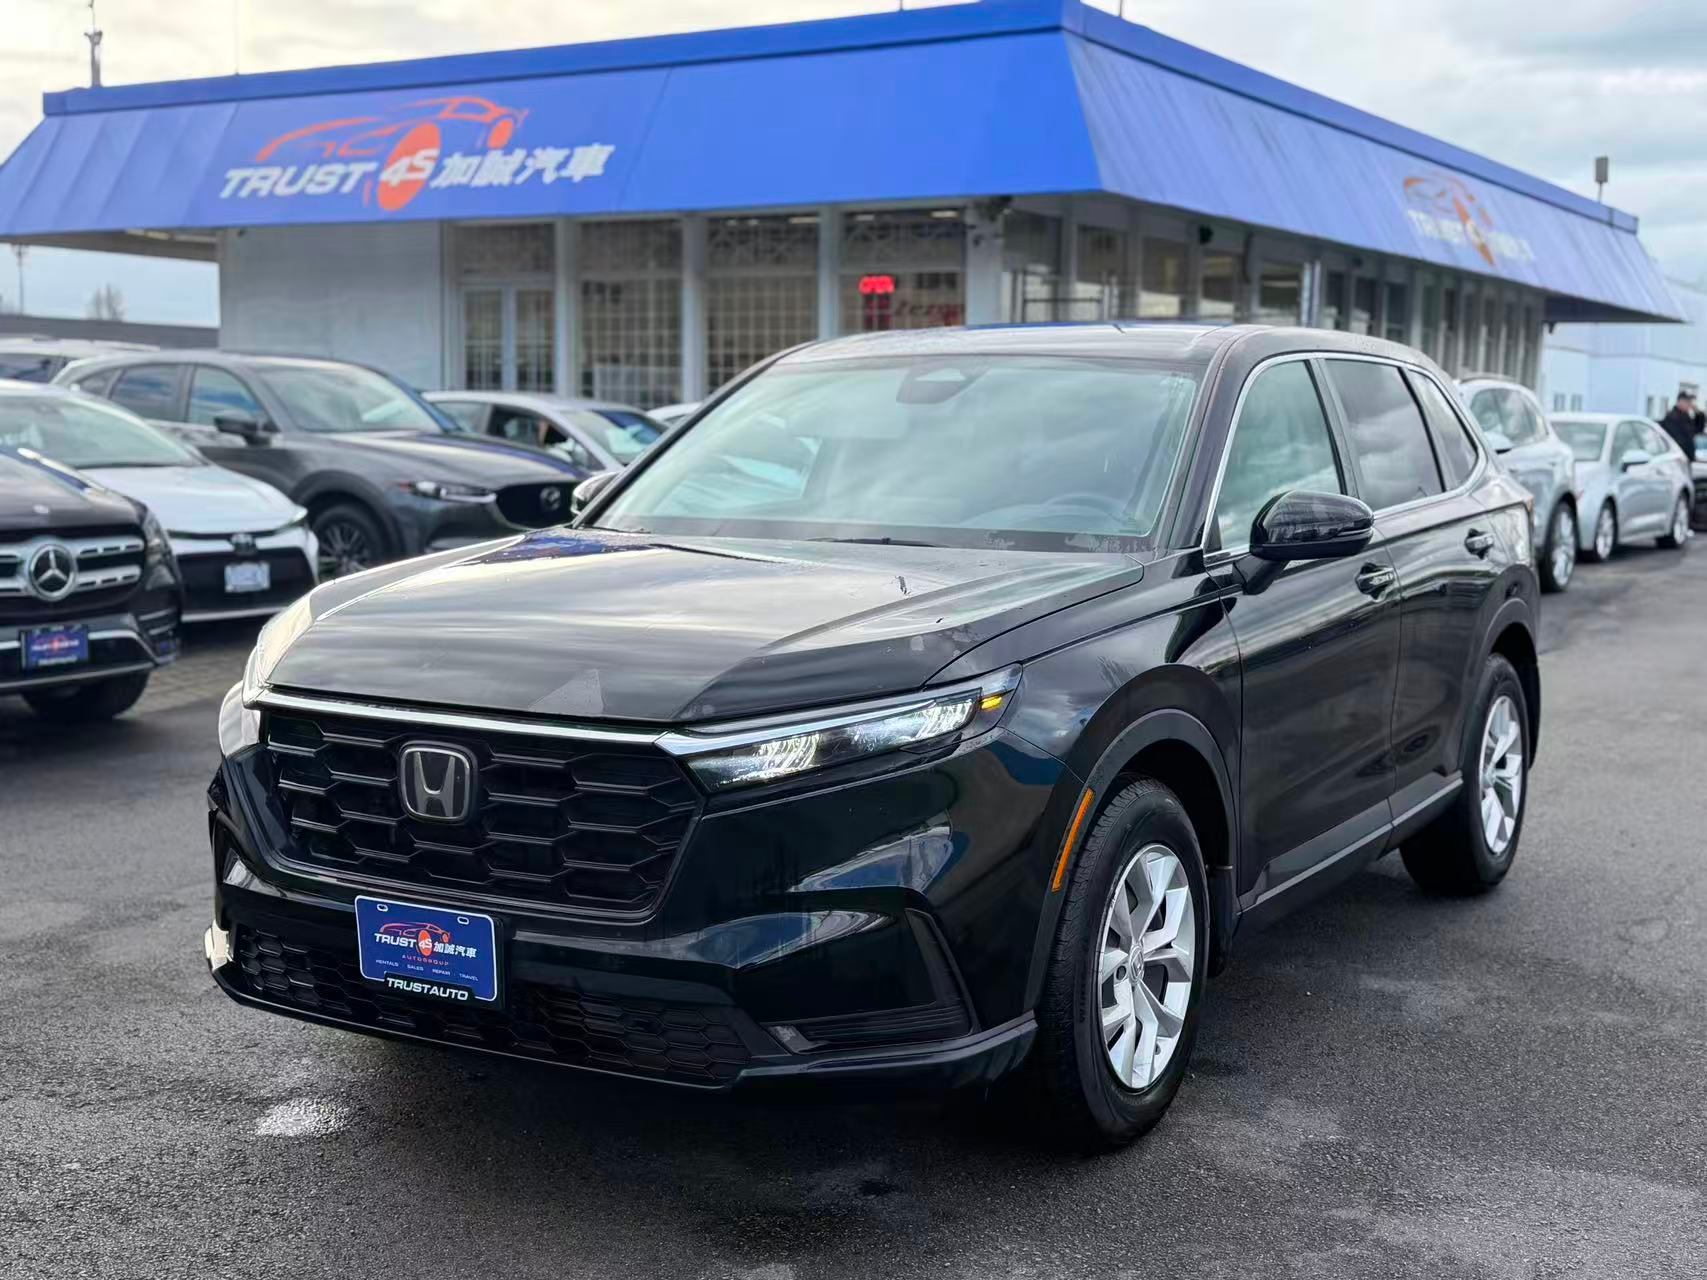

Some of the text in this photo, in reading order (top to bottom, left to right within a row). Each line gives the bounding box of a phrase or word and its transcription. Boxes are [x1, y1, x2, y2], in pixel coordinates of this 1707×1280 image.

[220, 161, 379, 199] TRUST
[374, 932, 417, 948] TRUST
[402, 954, 449, 966] AUTOGROUP
[386, 977, 469, 1000] TRUSTAUTO
